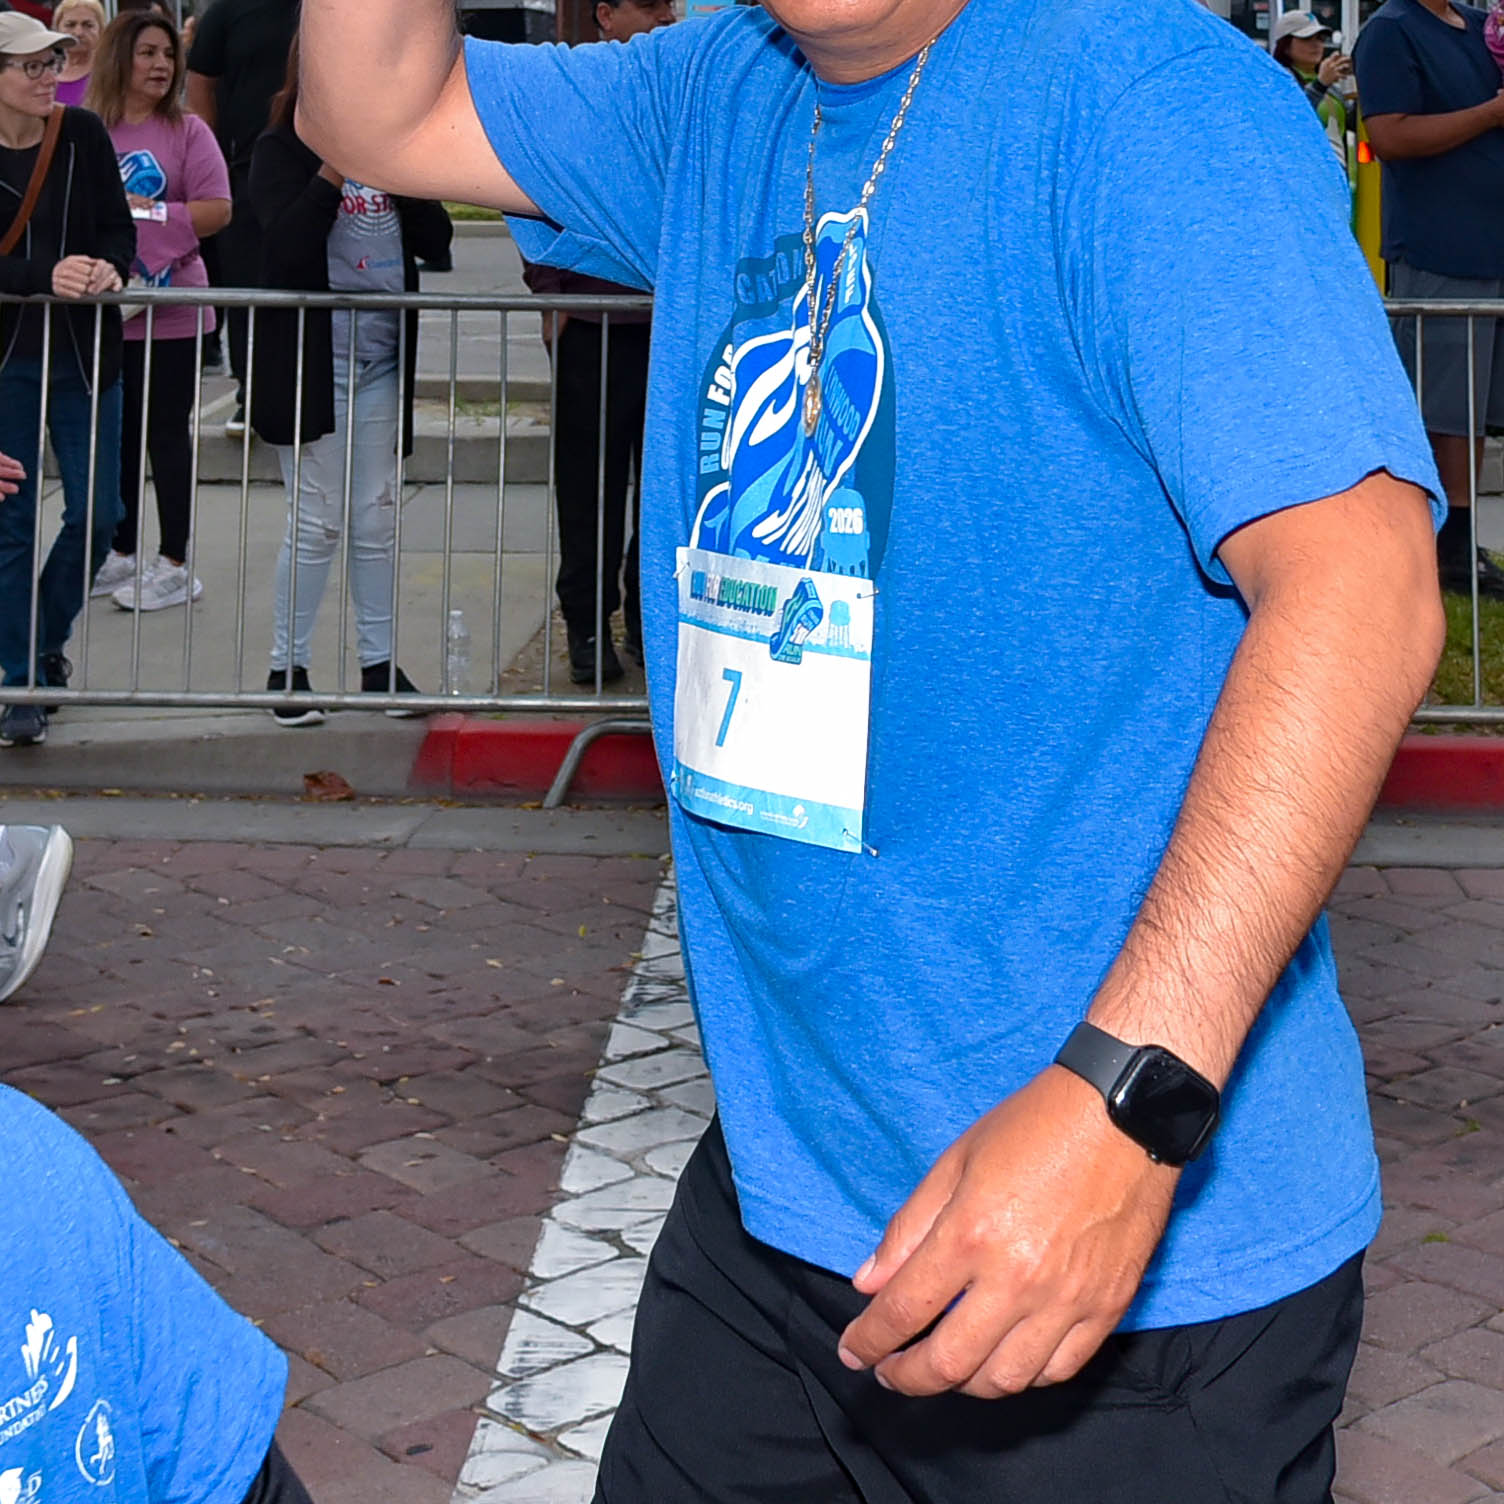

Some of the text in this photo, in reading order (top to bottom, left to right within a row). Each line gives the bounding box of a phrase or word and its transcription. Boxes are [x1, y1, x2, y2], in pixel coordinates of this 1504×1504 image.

[699, 408, 727, 475] RUN
[828, 507, 865, 535] 2026
[715, 668, 743, 747] 7
